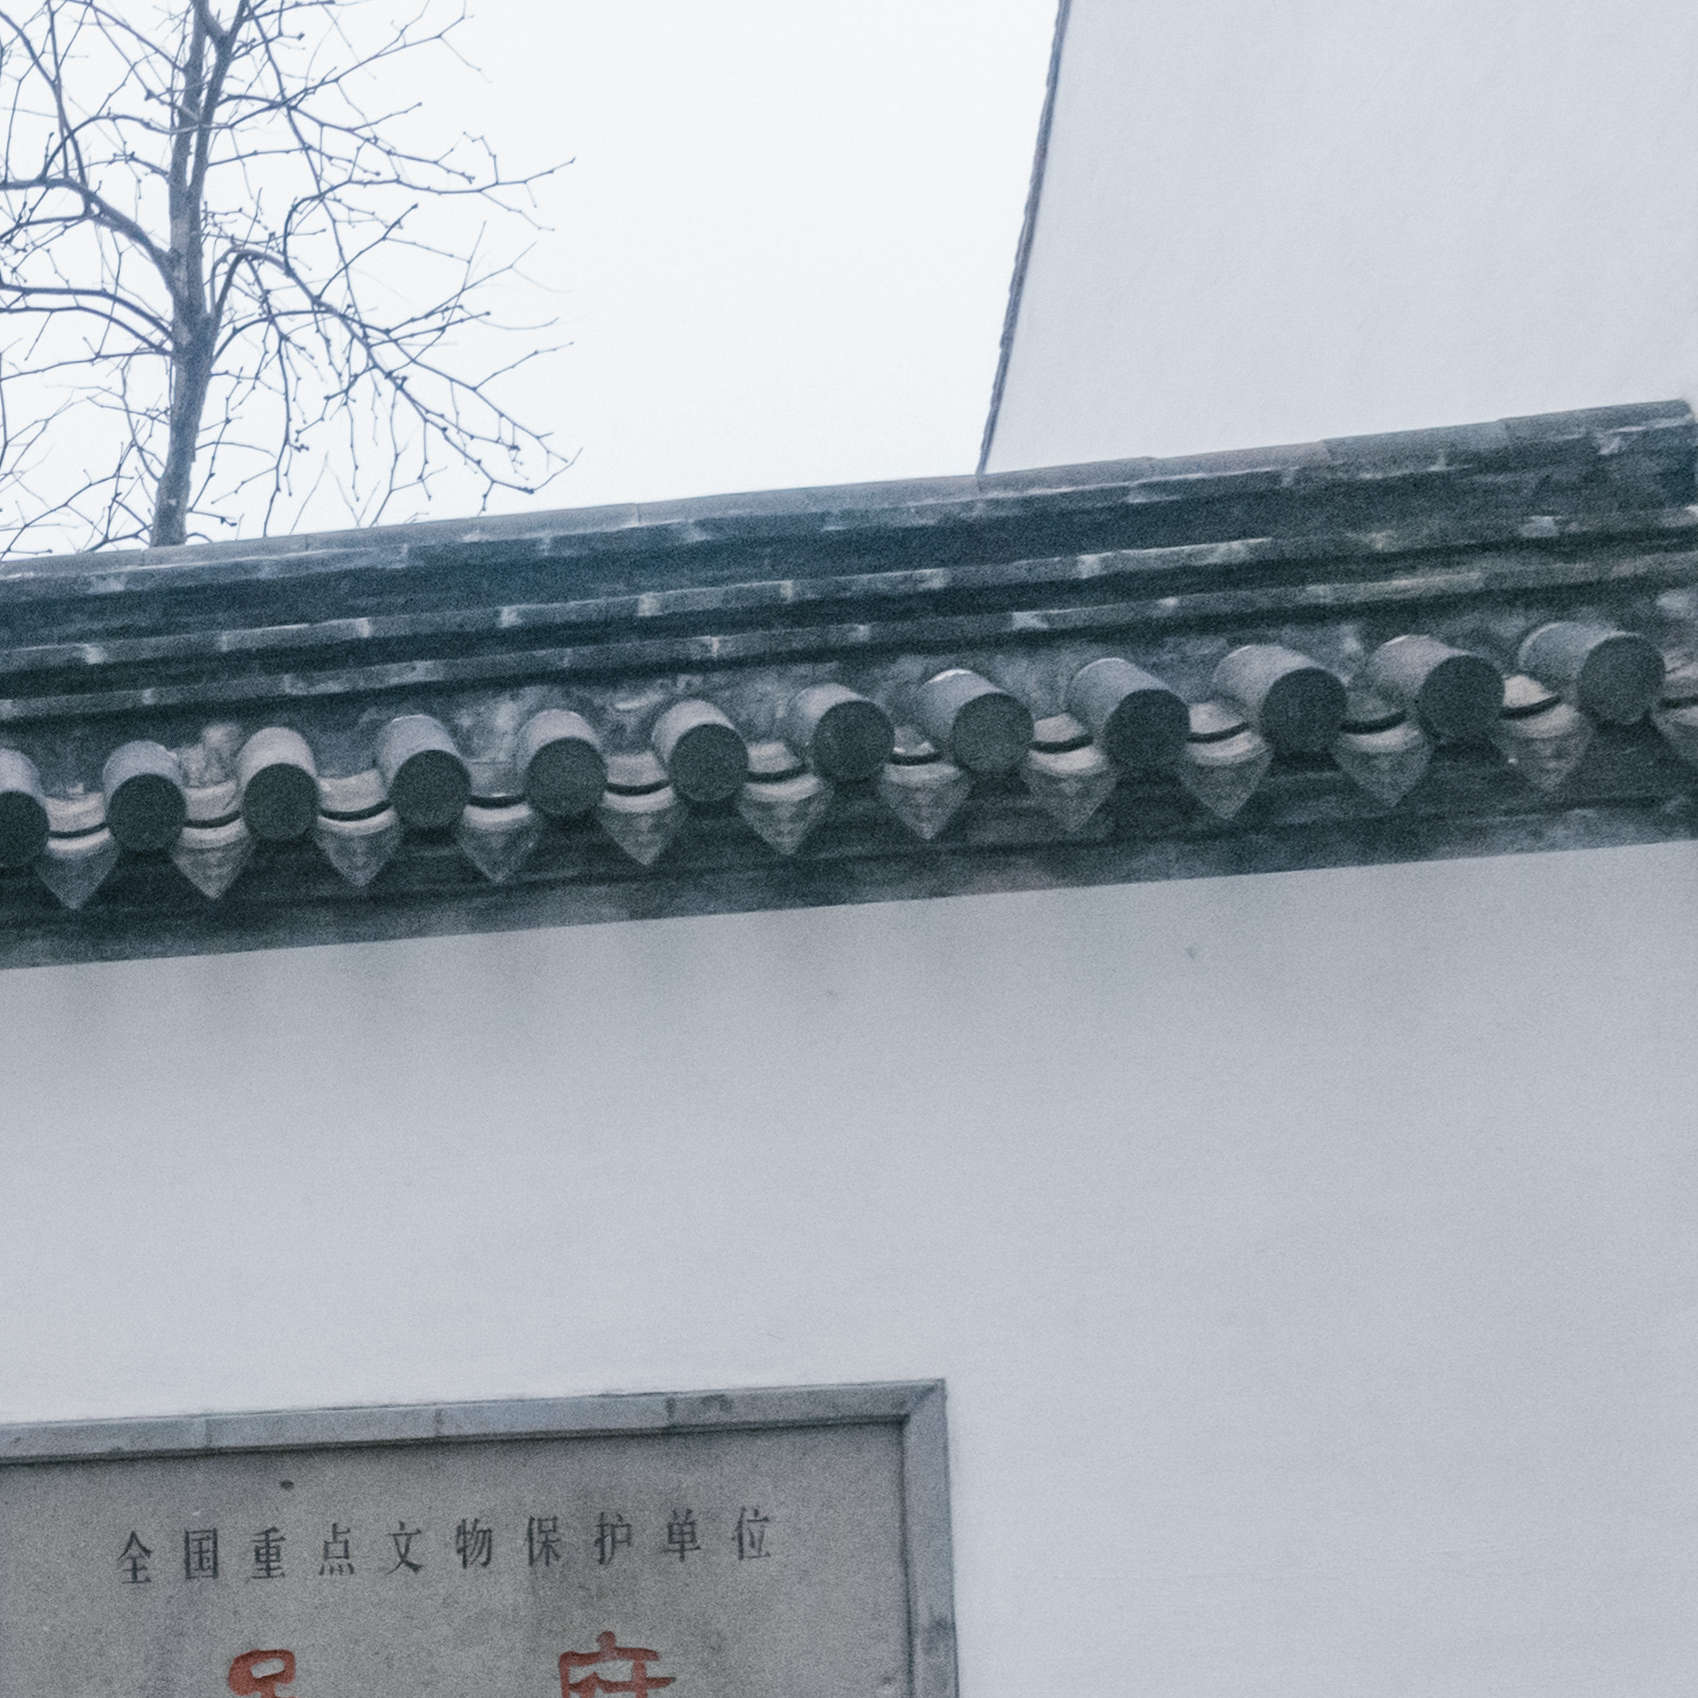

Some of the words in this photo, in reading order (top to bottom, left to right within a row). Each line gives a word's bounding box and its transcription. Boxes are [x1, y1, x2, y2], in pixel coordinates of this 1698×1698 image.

[116, 1506, 772, 1584] 全国重点文物保护单位
